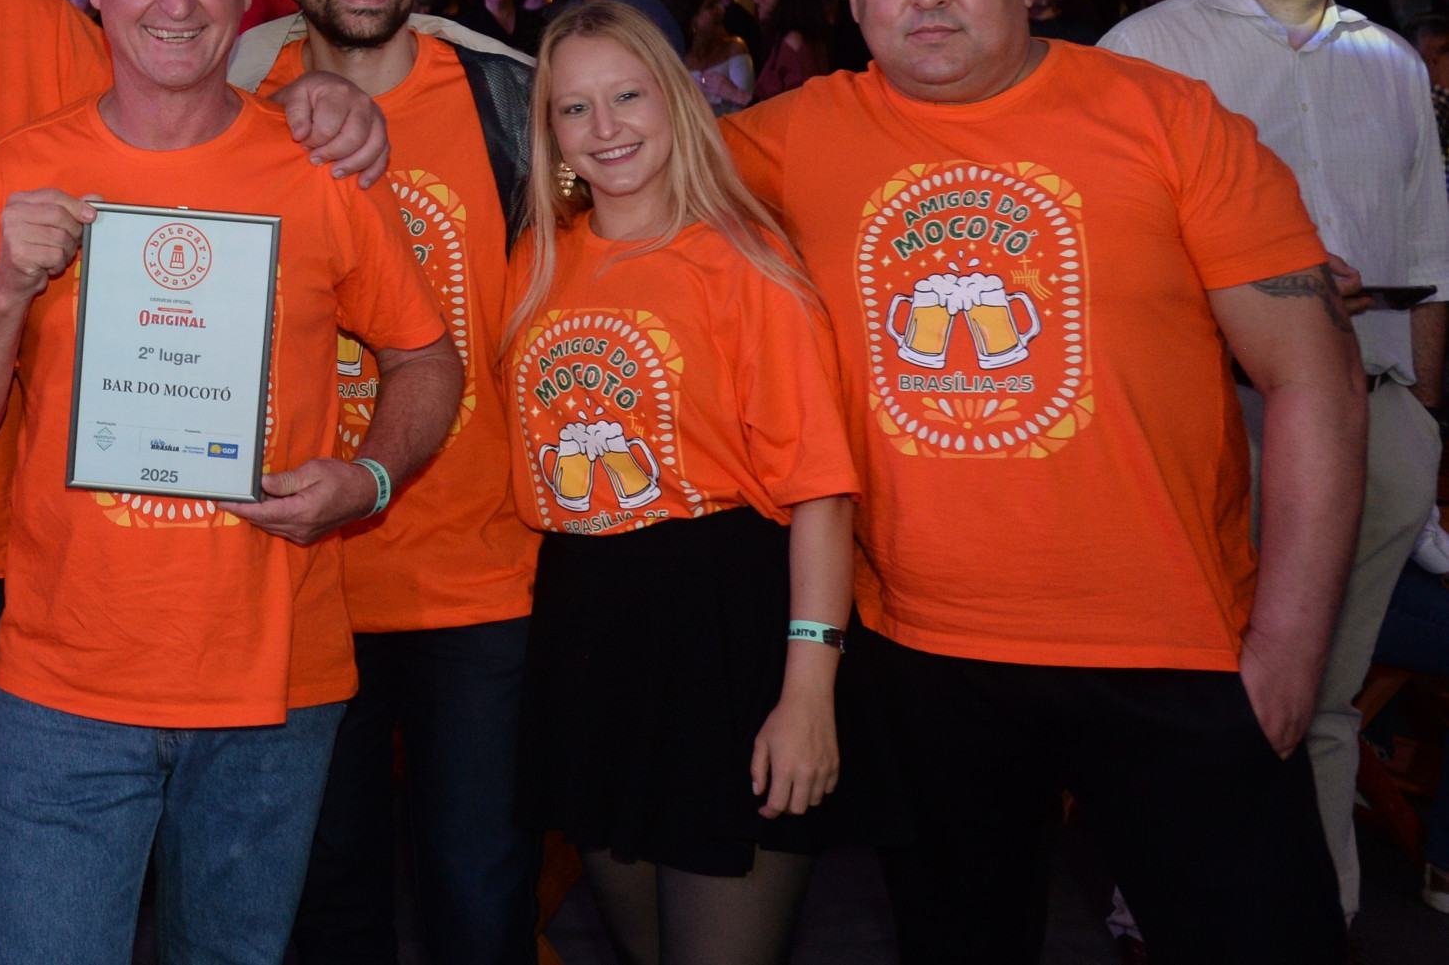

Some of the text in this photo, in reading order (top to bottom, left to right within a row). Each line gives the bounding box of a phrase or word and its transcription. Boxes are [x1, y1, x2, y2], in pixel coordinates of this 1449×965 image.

[902, 190, 1031, 227] AMIGOS DO
[891, 215, 1038, 260] MOCOTÓ
[139, 309, 207, 329] ORIGINAL
[138, 346, 201, 366] 2º lugar
[537, 336, 639, 378] AMIGOS DO
[102, 378, 231, 402] BAR DO MOCOTÓ
[534, 362, 643, 412] MOCOTÓ
[898, 371, 1035, 394] BRASÍLIA-25
[140, 468, 179, 484] 2025
